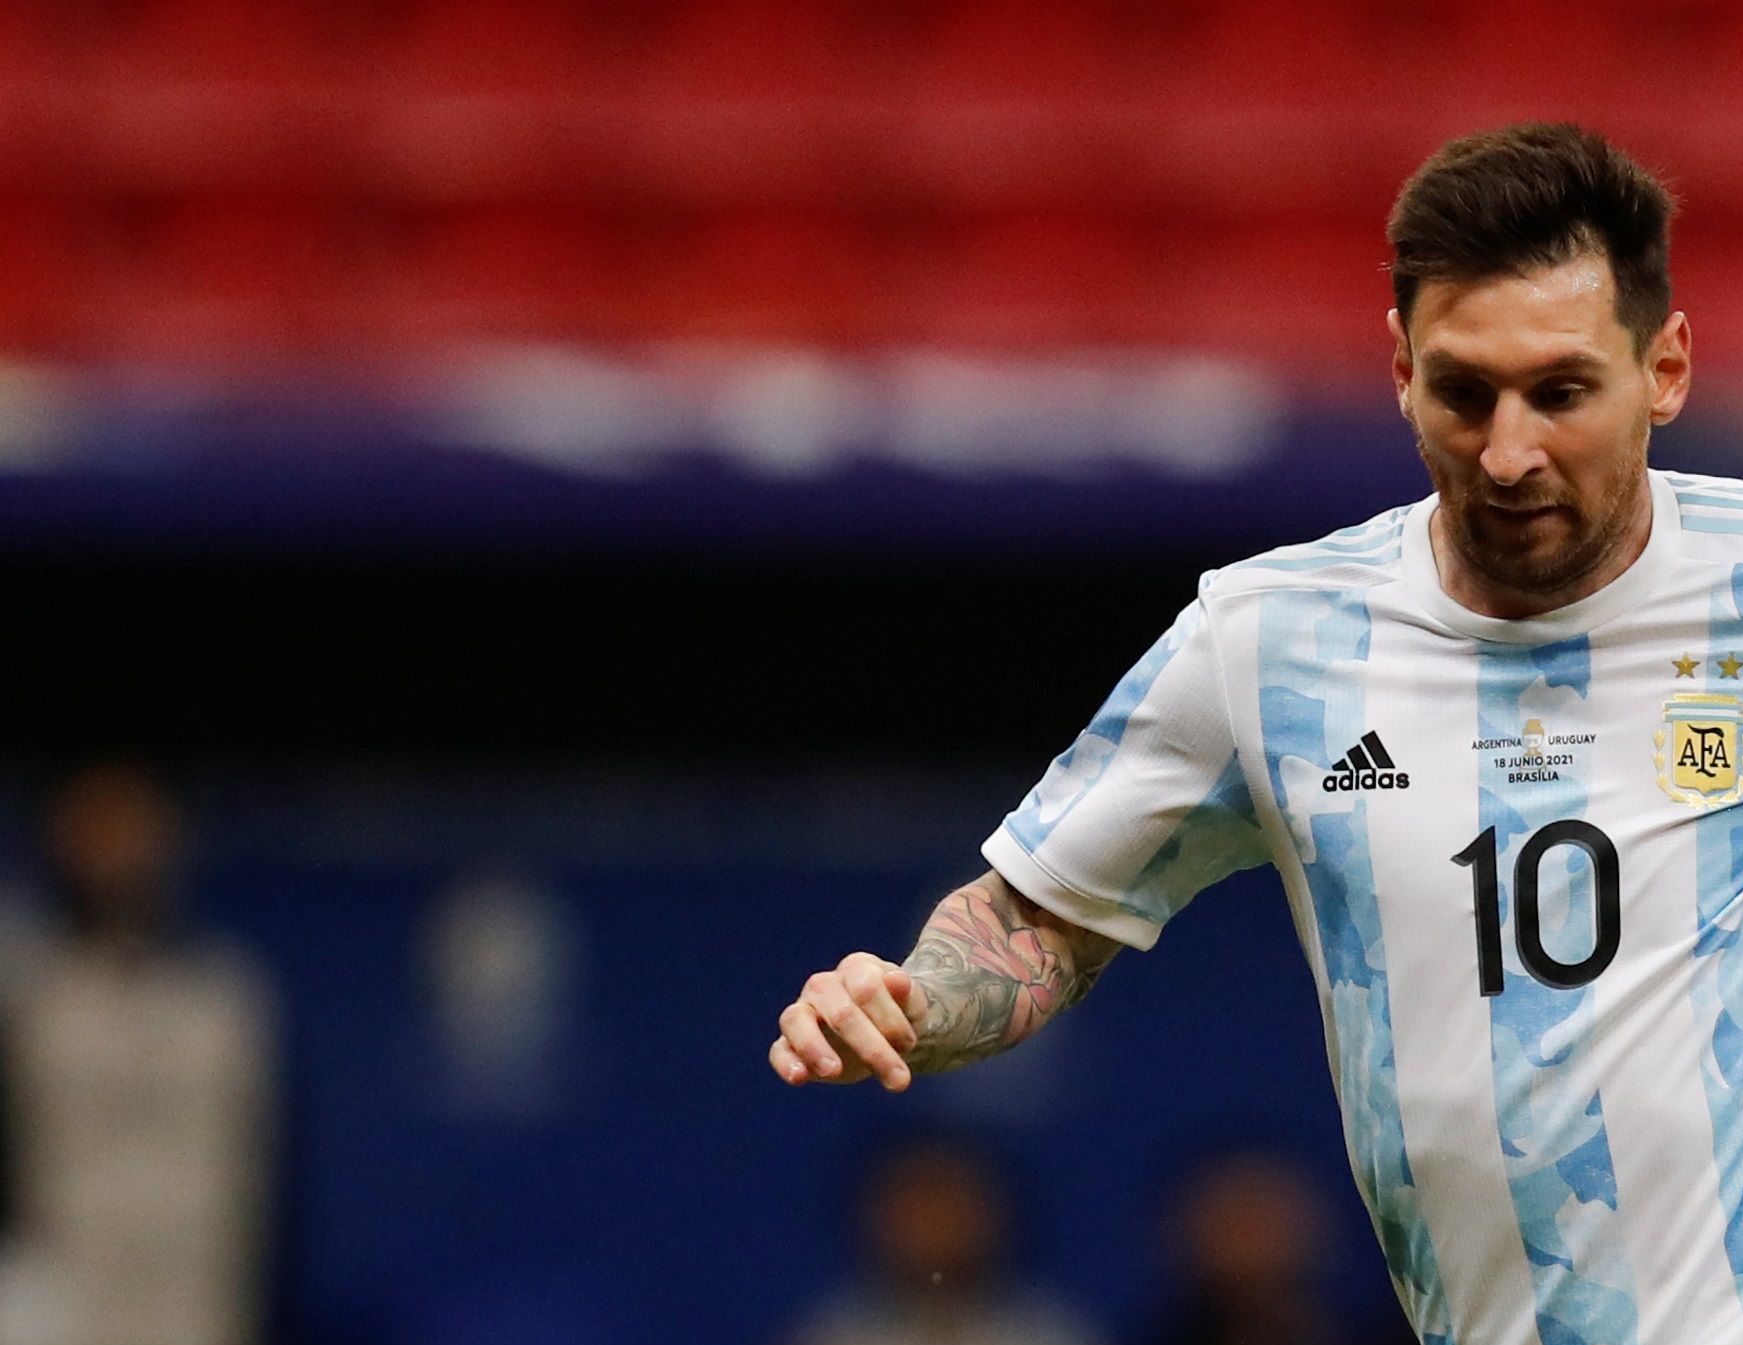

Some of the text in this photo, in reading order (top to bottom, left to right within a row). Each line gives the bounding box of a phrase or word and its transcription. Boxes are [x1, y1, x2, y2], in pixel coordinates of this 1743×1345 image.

[1472, 734, 1597, 750] ARGENTINA URUGUAY
[1677, 723, 1731, 777] AFA
[1494, 754, 1574, 768] 18 JUNIO 2021
[1322, 767, 1410, 793] adidas
[1508, 769, 1560, 784] BRASÍLIA
[1450, 819, 1622, 998] 10
